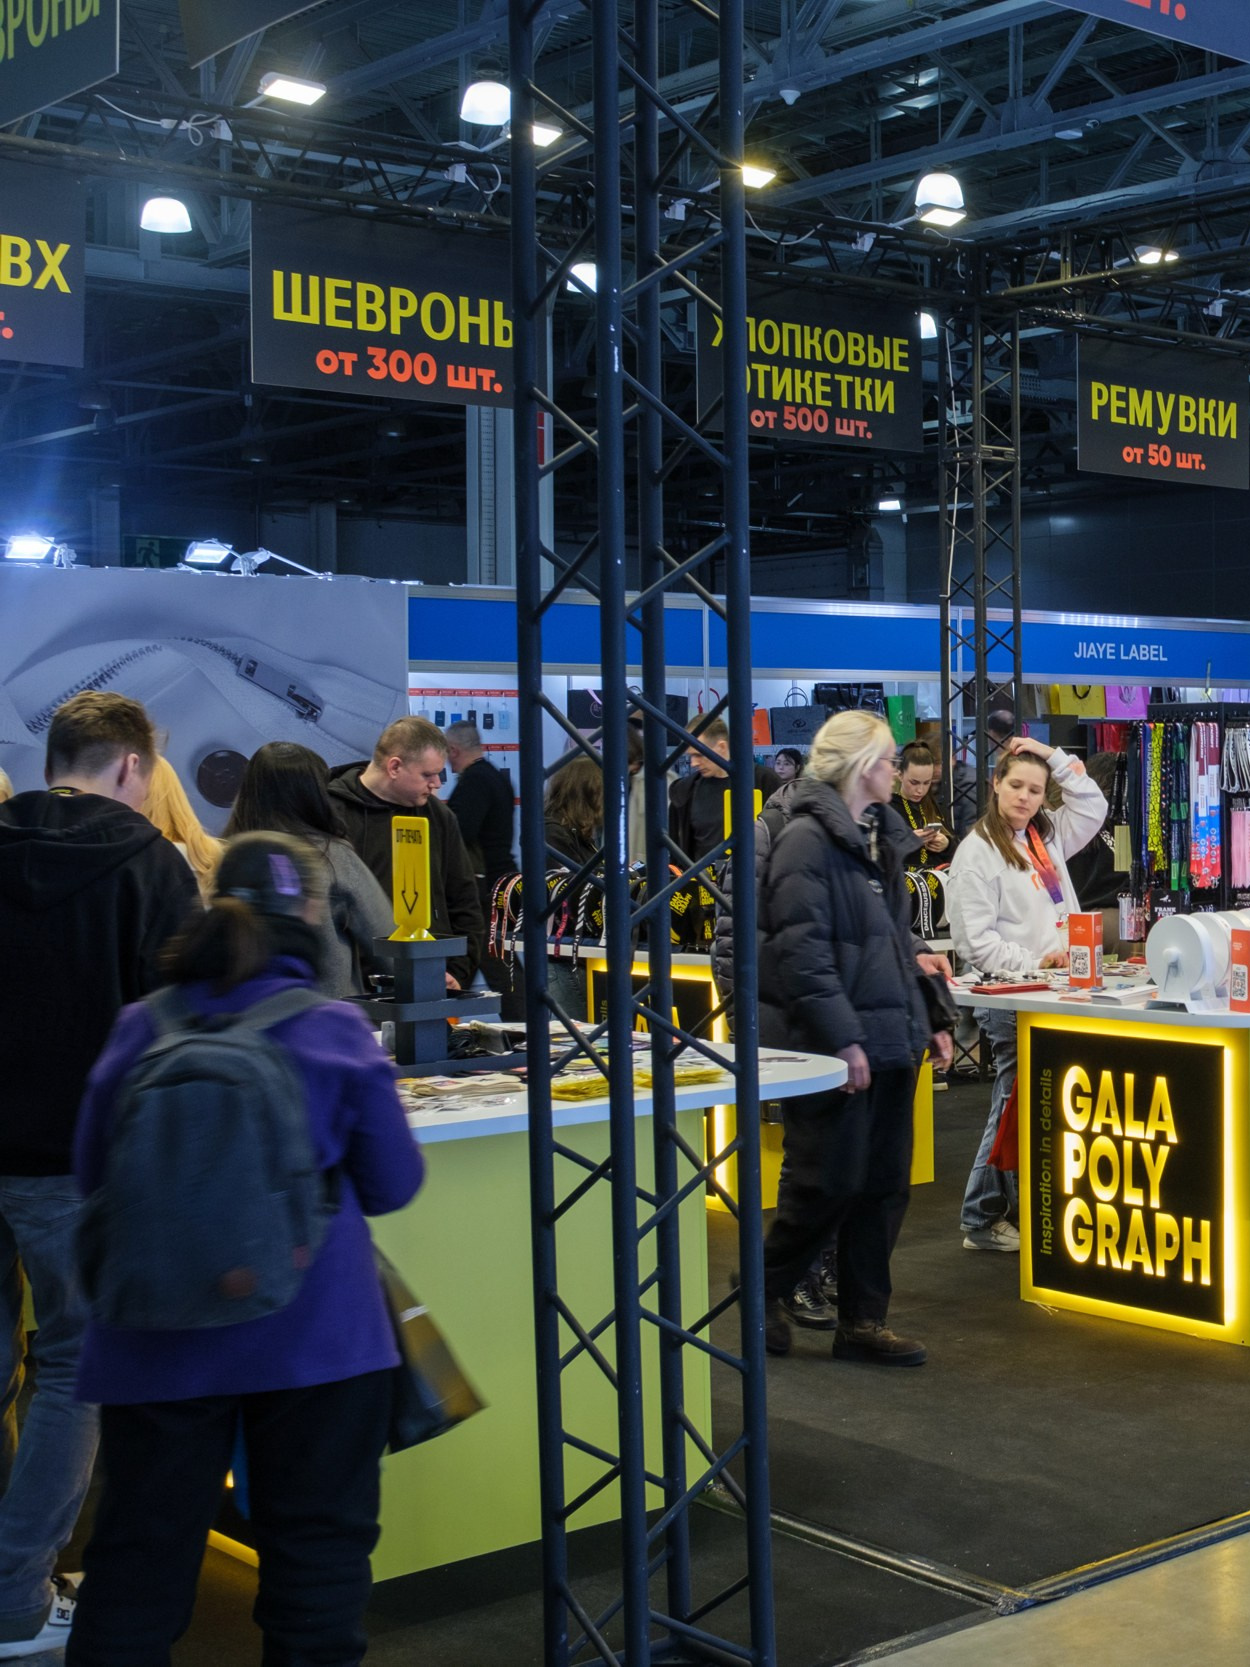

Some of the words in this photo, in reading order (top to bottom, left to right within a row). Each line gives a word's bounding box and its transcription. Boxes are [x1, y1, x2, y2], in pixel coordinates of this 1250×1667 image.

[316, 349, 358, 375] от
[366, 347, 437, 384] 300
[446, 365, 503, 393] шт.
[746, 362, 895, 414] ТИКЕТКИ
[750, 408, 775, 429] от
[783, 406, 827, 432] 500
[835, 417, 873, 440] шт.
[1091, 382, 1237, 439] РЕМУВКИ
[1123, 447, 1143, 463] от
[1148, 445, 1171, 467] 50
[1176, 455, 1206, 471] шт.
[1074, 642, 1115, 661] JIAYE
[1120, 643, 1168, 662] LABEL
[1040, 1068, 1052, 1133] details
[1062, 1065, 1178, 1144] GALA
[1040, 1139, 1052, 1155] in
[1063, 1131, 1170, 1209] POLY
[1040, 1158, 1052, 1255] inspiration
[1063, 1197, 1211, 1286] GRAPH
